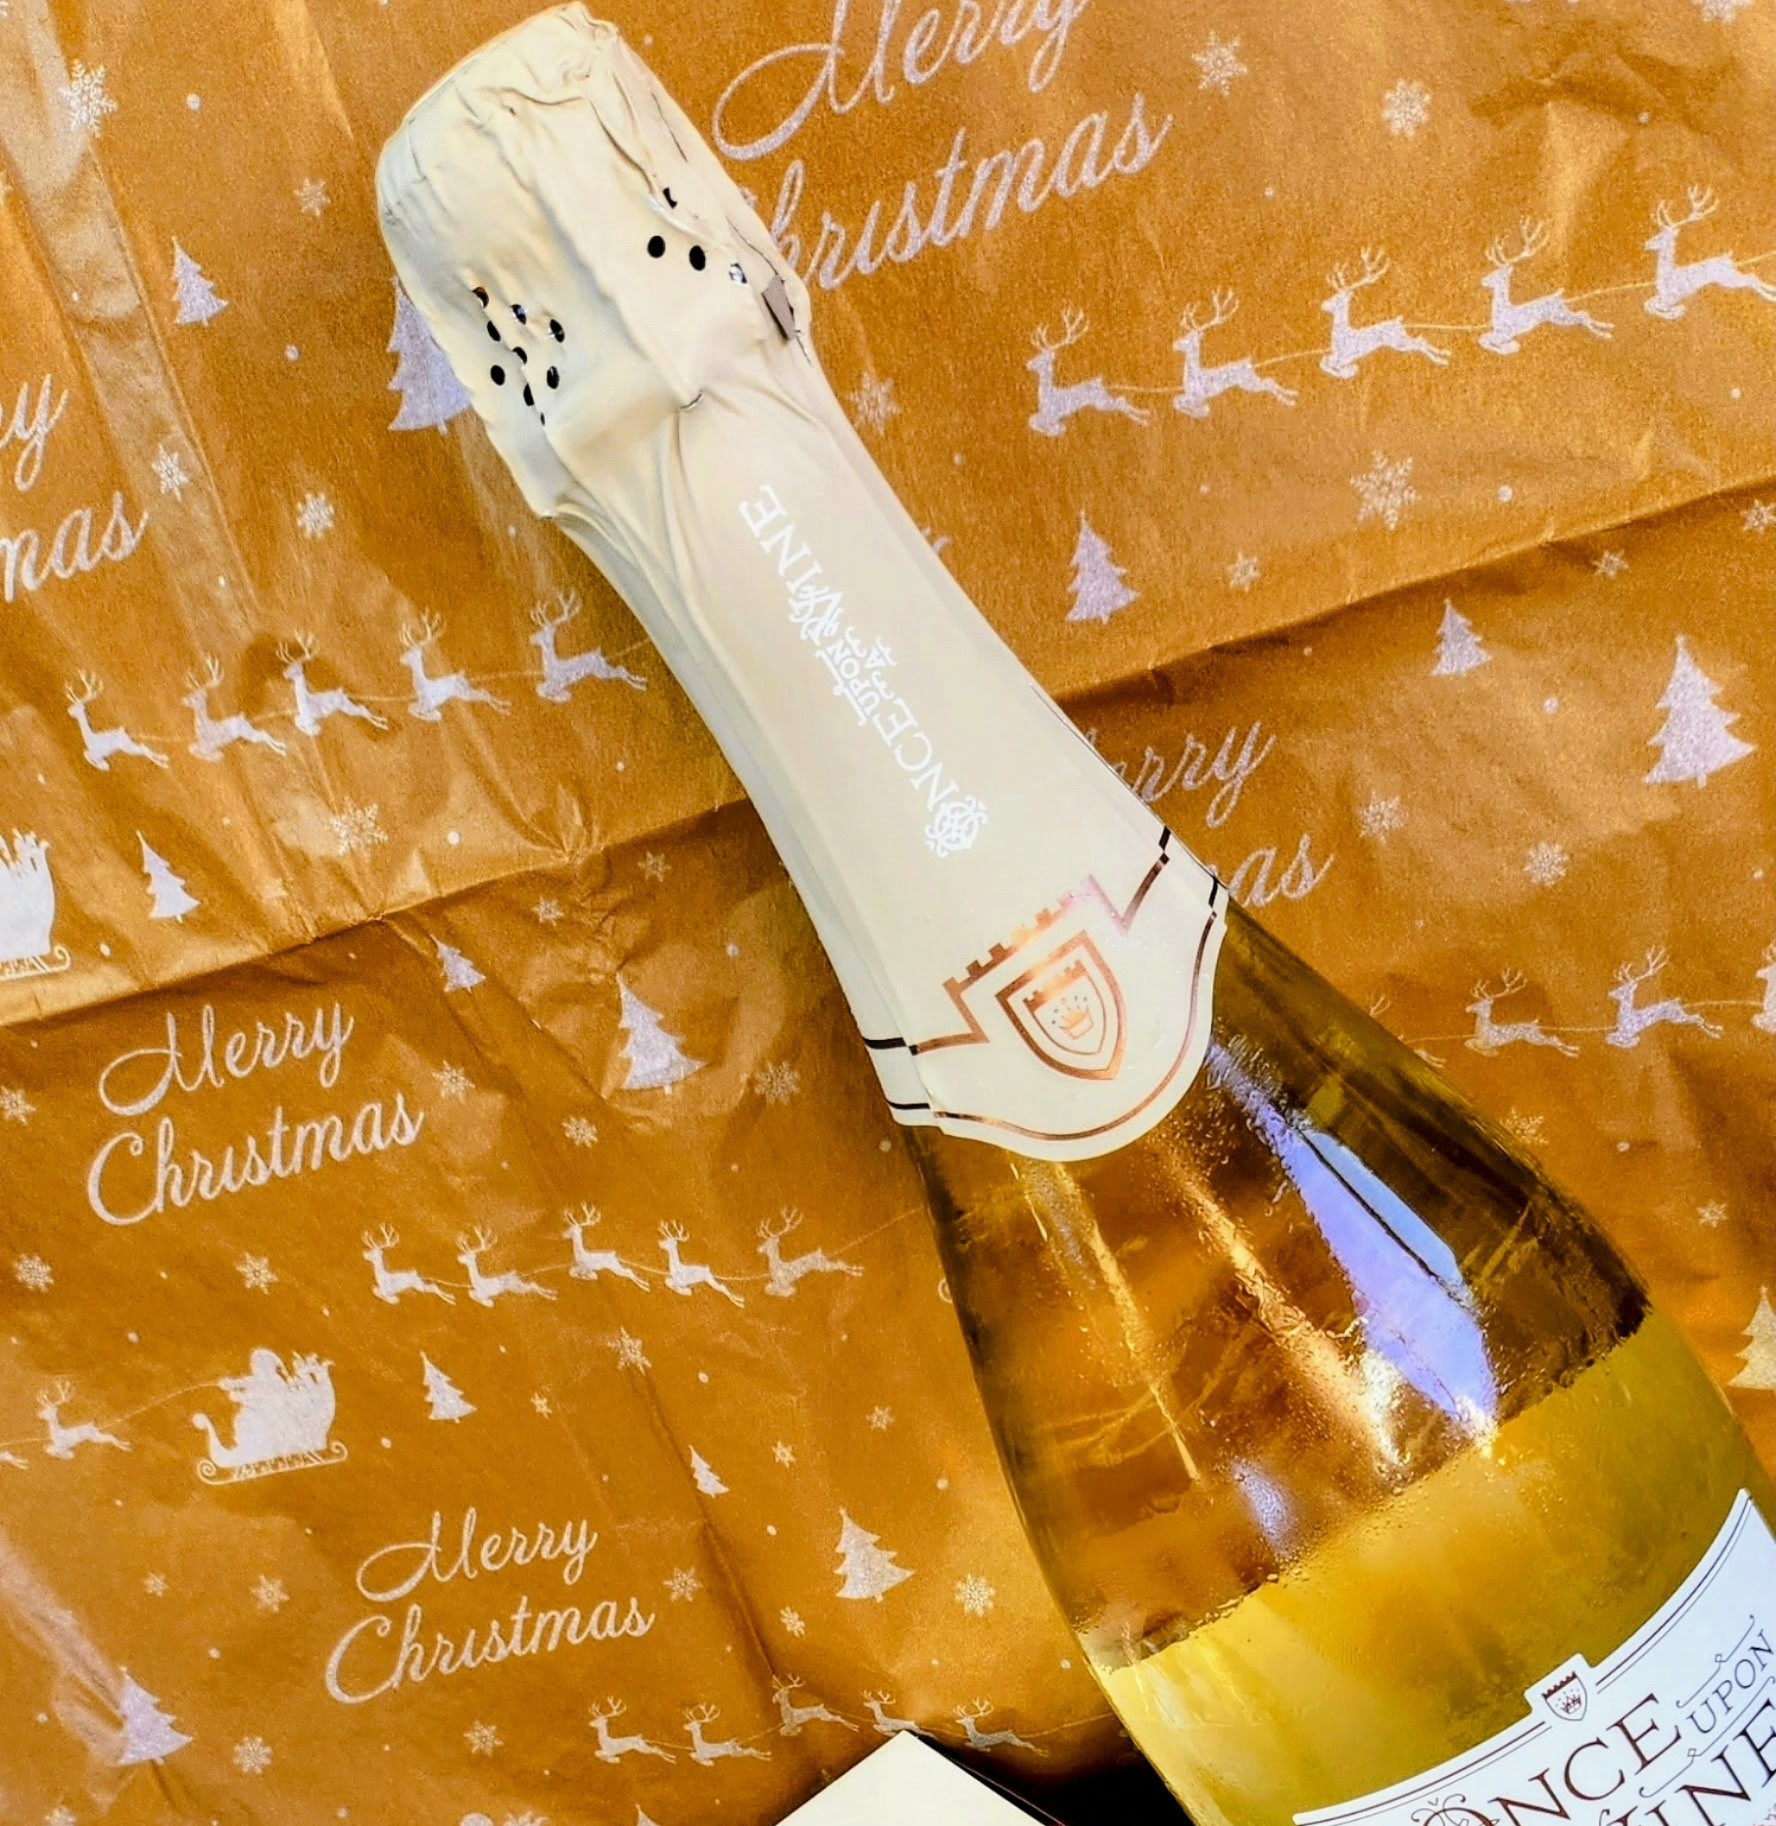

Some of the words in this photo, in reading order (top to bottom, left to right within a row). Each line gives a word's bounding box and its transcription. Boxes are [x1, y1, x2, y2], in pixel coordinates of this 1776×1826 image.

[741, 93, 1173, 289] hristmas
[739, 485, 843, 645] VINE
[872, 698, 987, 858] ONCE
[1083, 720, 1277, 829] rry
[100, 1001, 355, 1116] Merry
[87, 1092, 424, 1225] Christmas
[356, 1507, 598, 1602] Merry
[325, 1597, 655, 1703] Christmas
[1686, 1629, 1774, 1733] UPON
